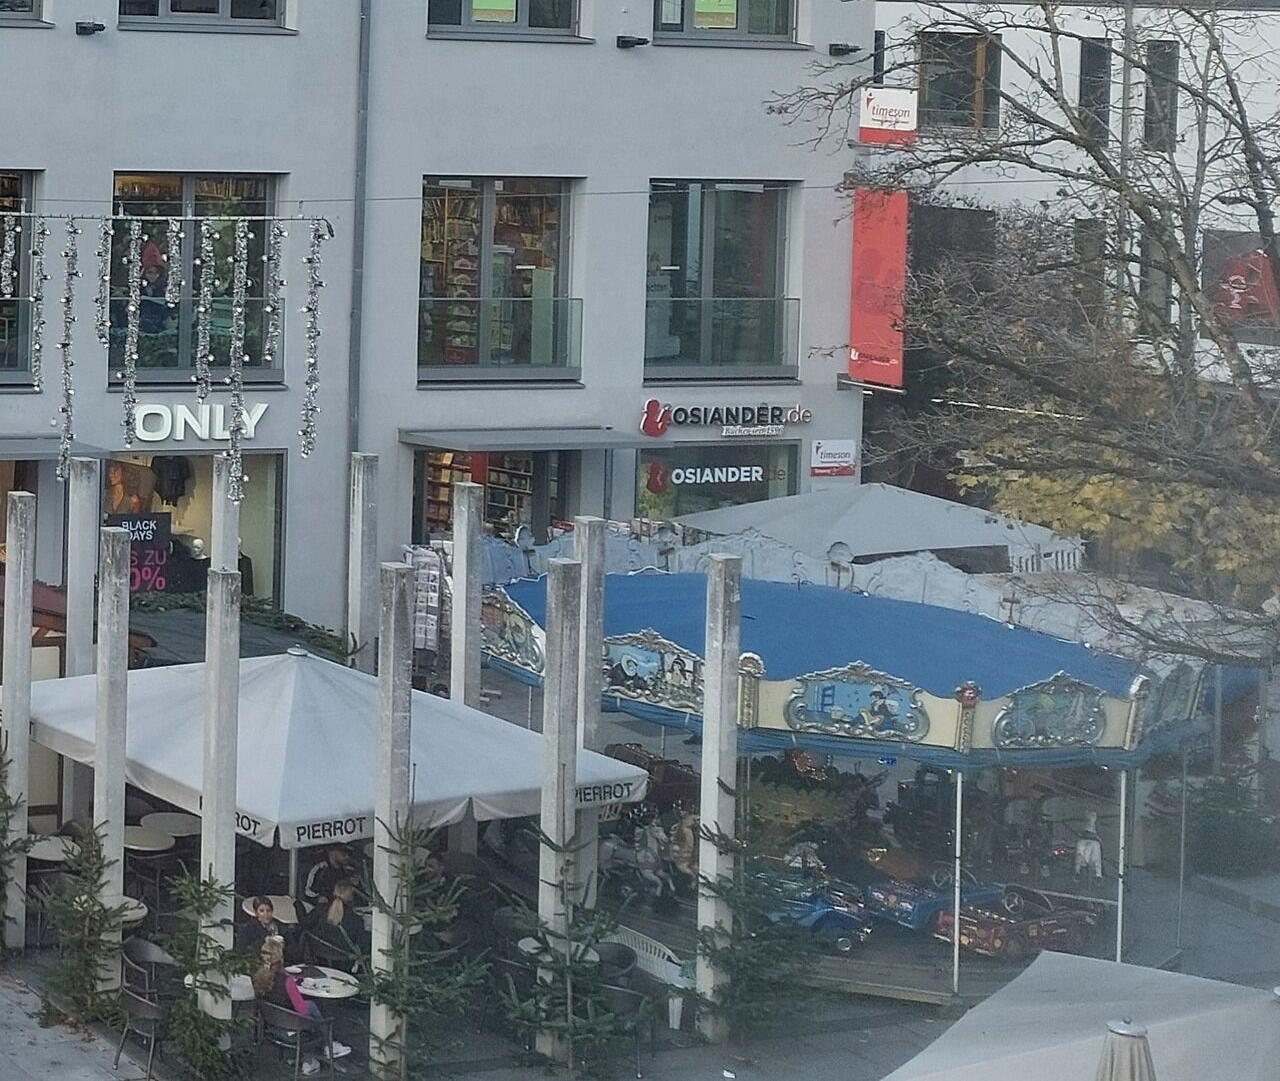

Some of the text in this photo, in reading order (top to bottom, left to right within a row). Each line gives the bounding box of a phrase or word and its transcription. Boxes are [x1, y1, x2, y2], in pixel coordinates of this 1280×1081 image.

[134, 402, 269, 441] ONLY
[121, 519, 157, 532] BLACK
[147, 549, 168, 566] ZU
[129, 566, 166, 592] 0%
[295, 816, 368, 842] PIERROT
